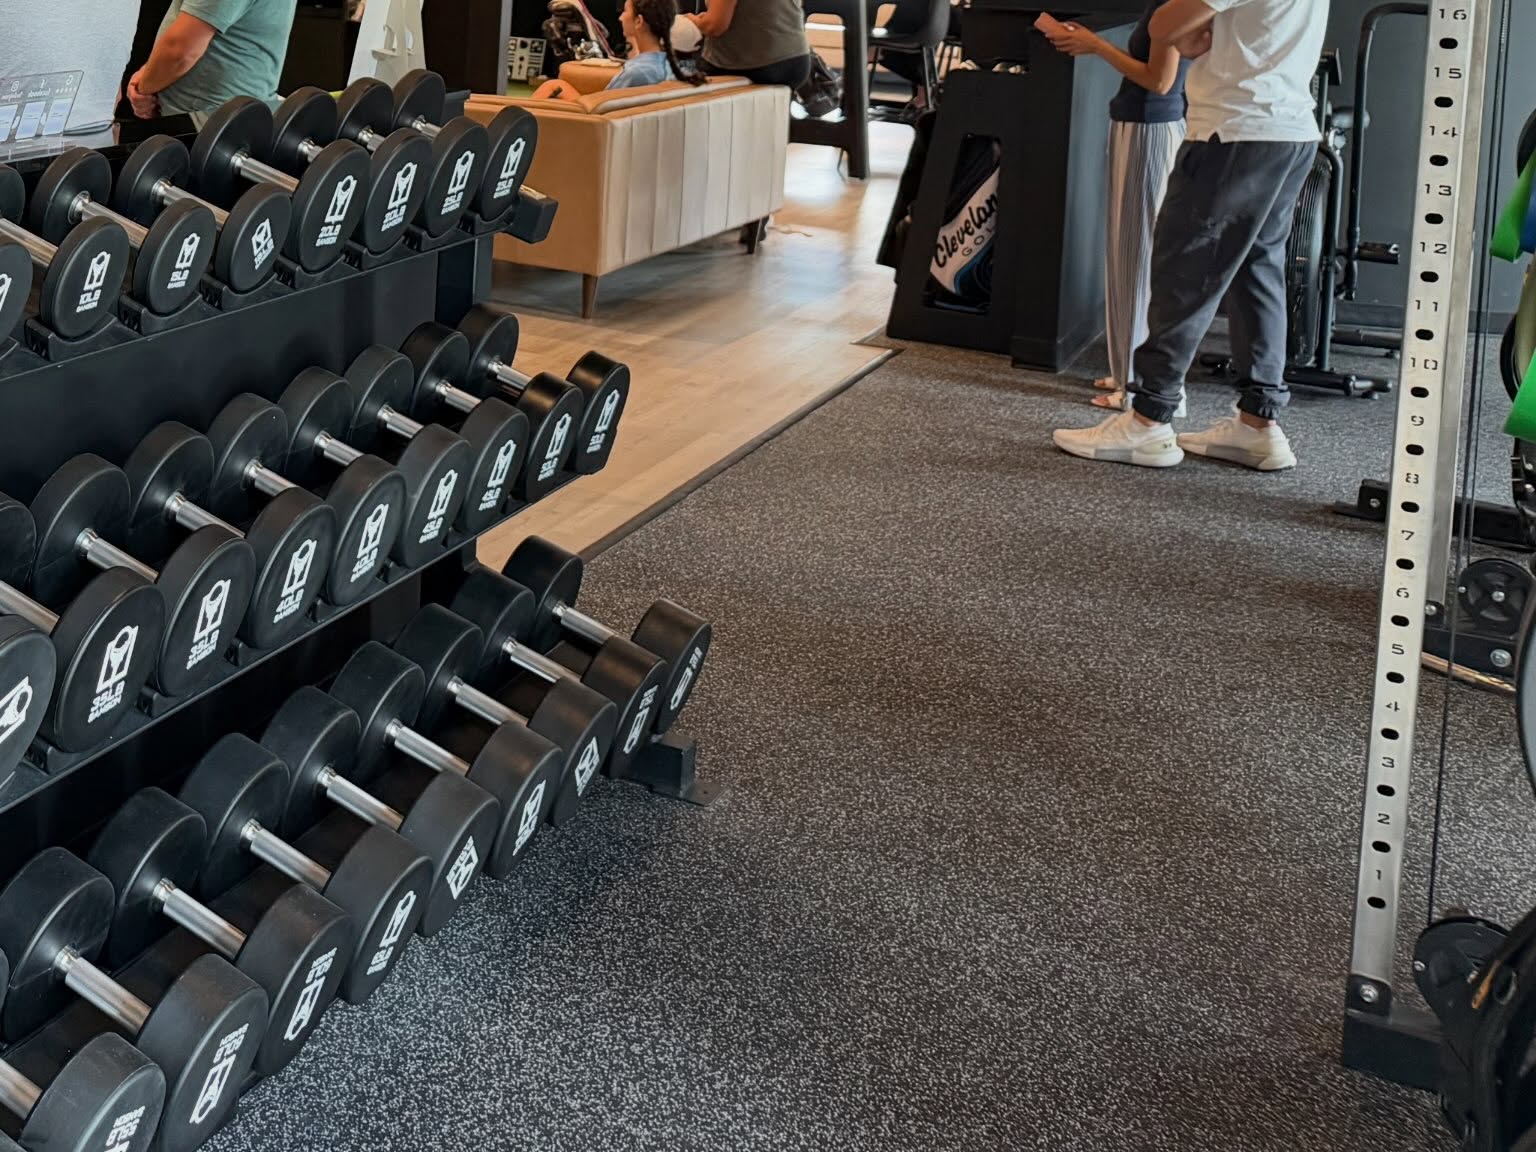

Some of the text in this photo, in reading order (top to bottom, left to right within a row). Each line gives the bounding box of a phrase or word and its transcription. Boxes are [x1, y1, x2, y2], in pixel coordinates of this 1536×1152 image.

[1439, 8, 1467, 21] 16
[1433, 66, 1463, 80] 15
[1429, 125, 1458, 138] 14
[1424, 183, 1452, 197] 13
[935, 193, 997, 268] Clevelan
[1419, 241, 1448, 255] 12
[78, 289, 102, 305] 10LB
[1415, 299, 1439, 313] 11
[1410, 357, 1439, 371] 10
[1410, 415, 1425, 427] 9
[1405, 472, 1420, 485] 8
[1401, 529, 1415, 541] 7
[1395, 587, 1410, 599] 6
[275, 588, 305, 613] 40LB
[188, 629, 220, 660] 35LB
[1391, 643, 1405, 655] 5
[90, 680, 125, 713] 35LB
[1385, 701, 1401, 713] 4
[1381, 756, 1395, 769] 3
[1376, 812, 1391, 825] 2
[1375, 869, 1382, 881] 1
